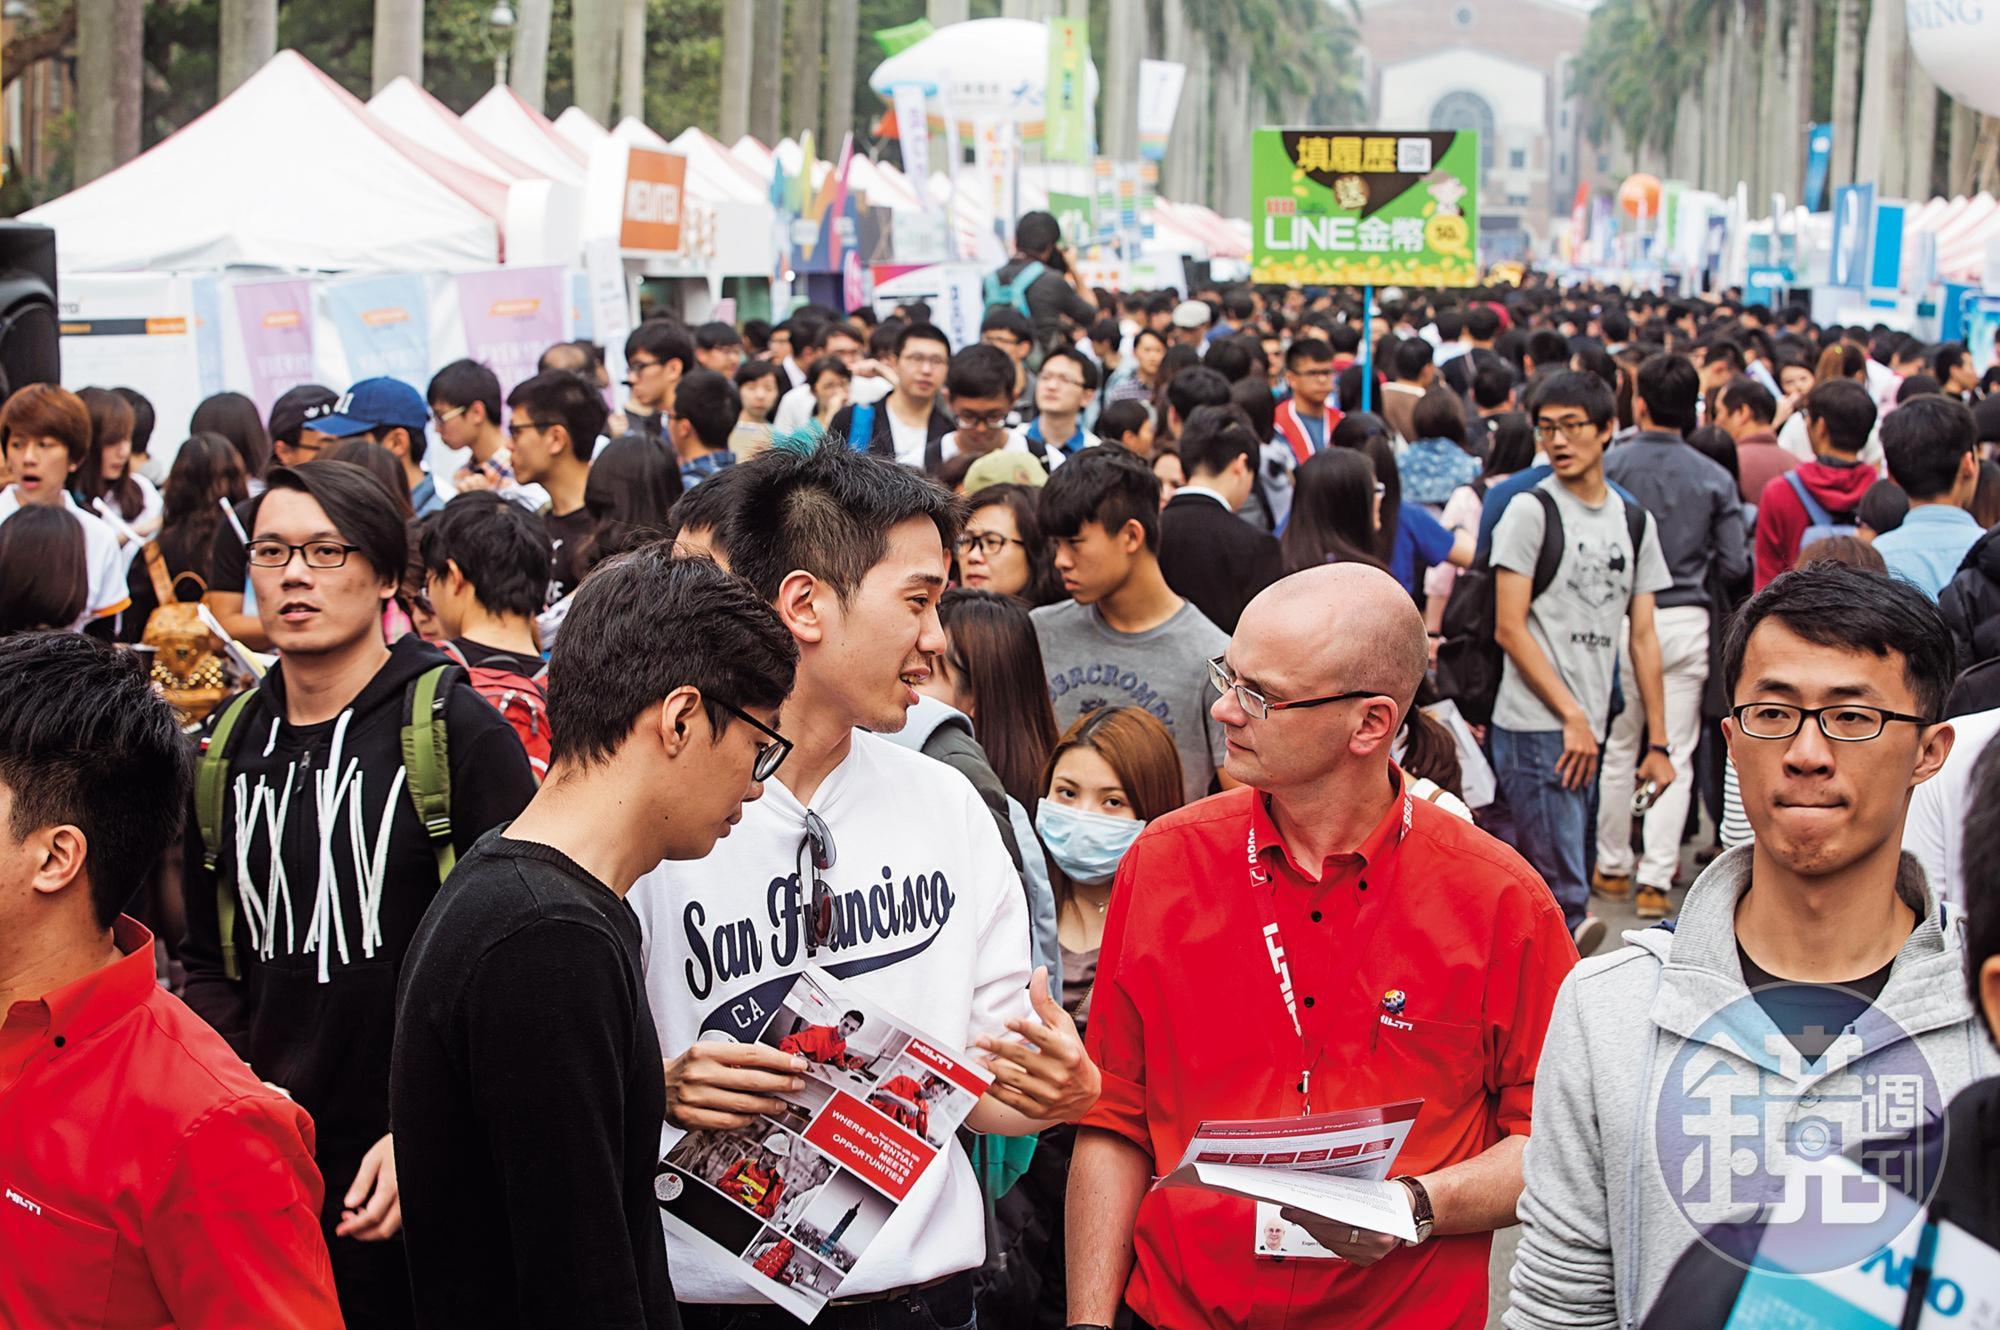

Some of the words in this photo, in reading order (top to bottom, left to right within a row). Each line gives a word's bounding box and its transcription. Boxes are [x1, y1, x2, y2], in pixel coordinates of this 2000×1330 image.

[684, 901, 762, 1000] San
[731, 996, 765, 1028] CA
[912, 1041, 954, 1070] HILTI
[832, 1110, 866, 1136] WHERE
[865, 1132, 914, 1170] POTENTIAL
[832, 1133, 904, 1185] OPPORTUNITIES
[879, 1152, 911, 1177] MEETS
[6, 1188, 41, 1216] HILTI
